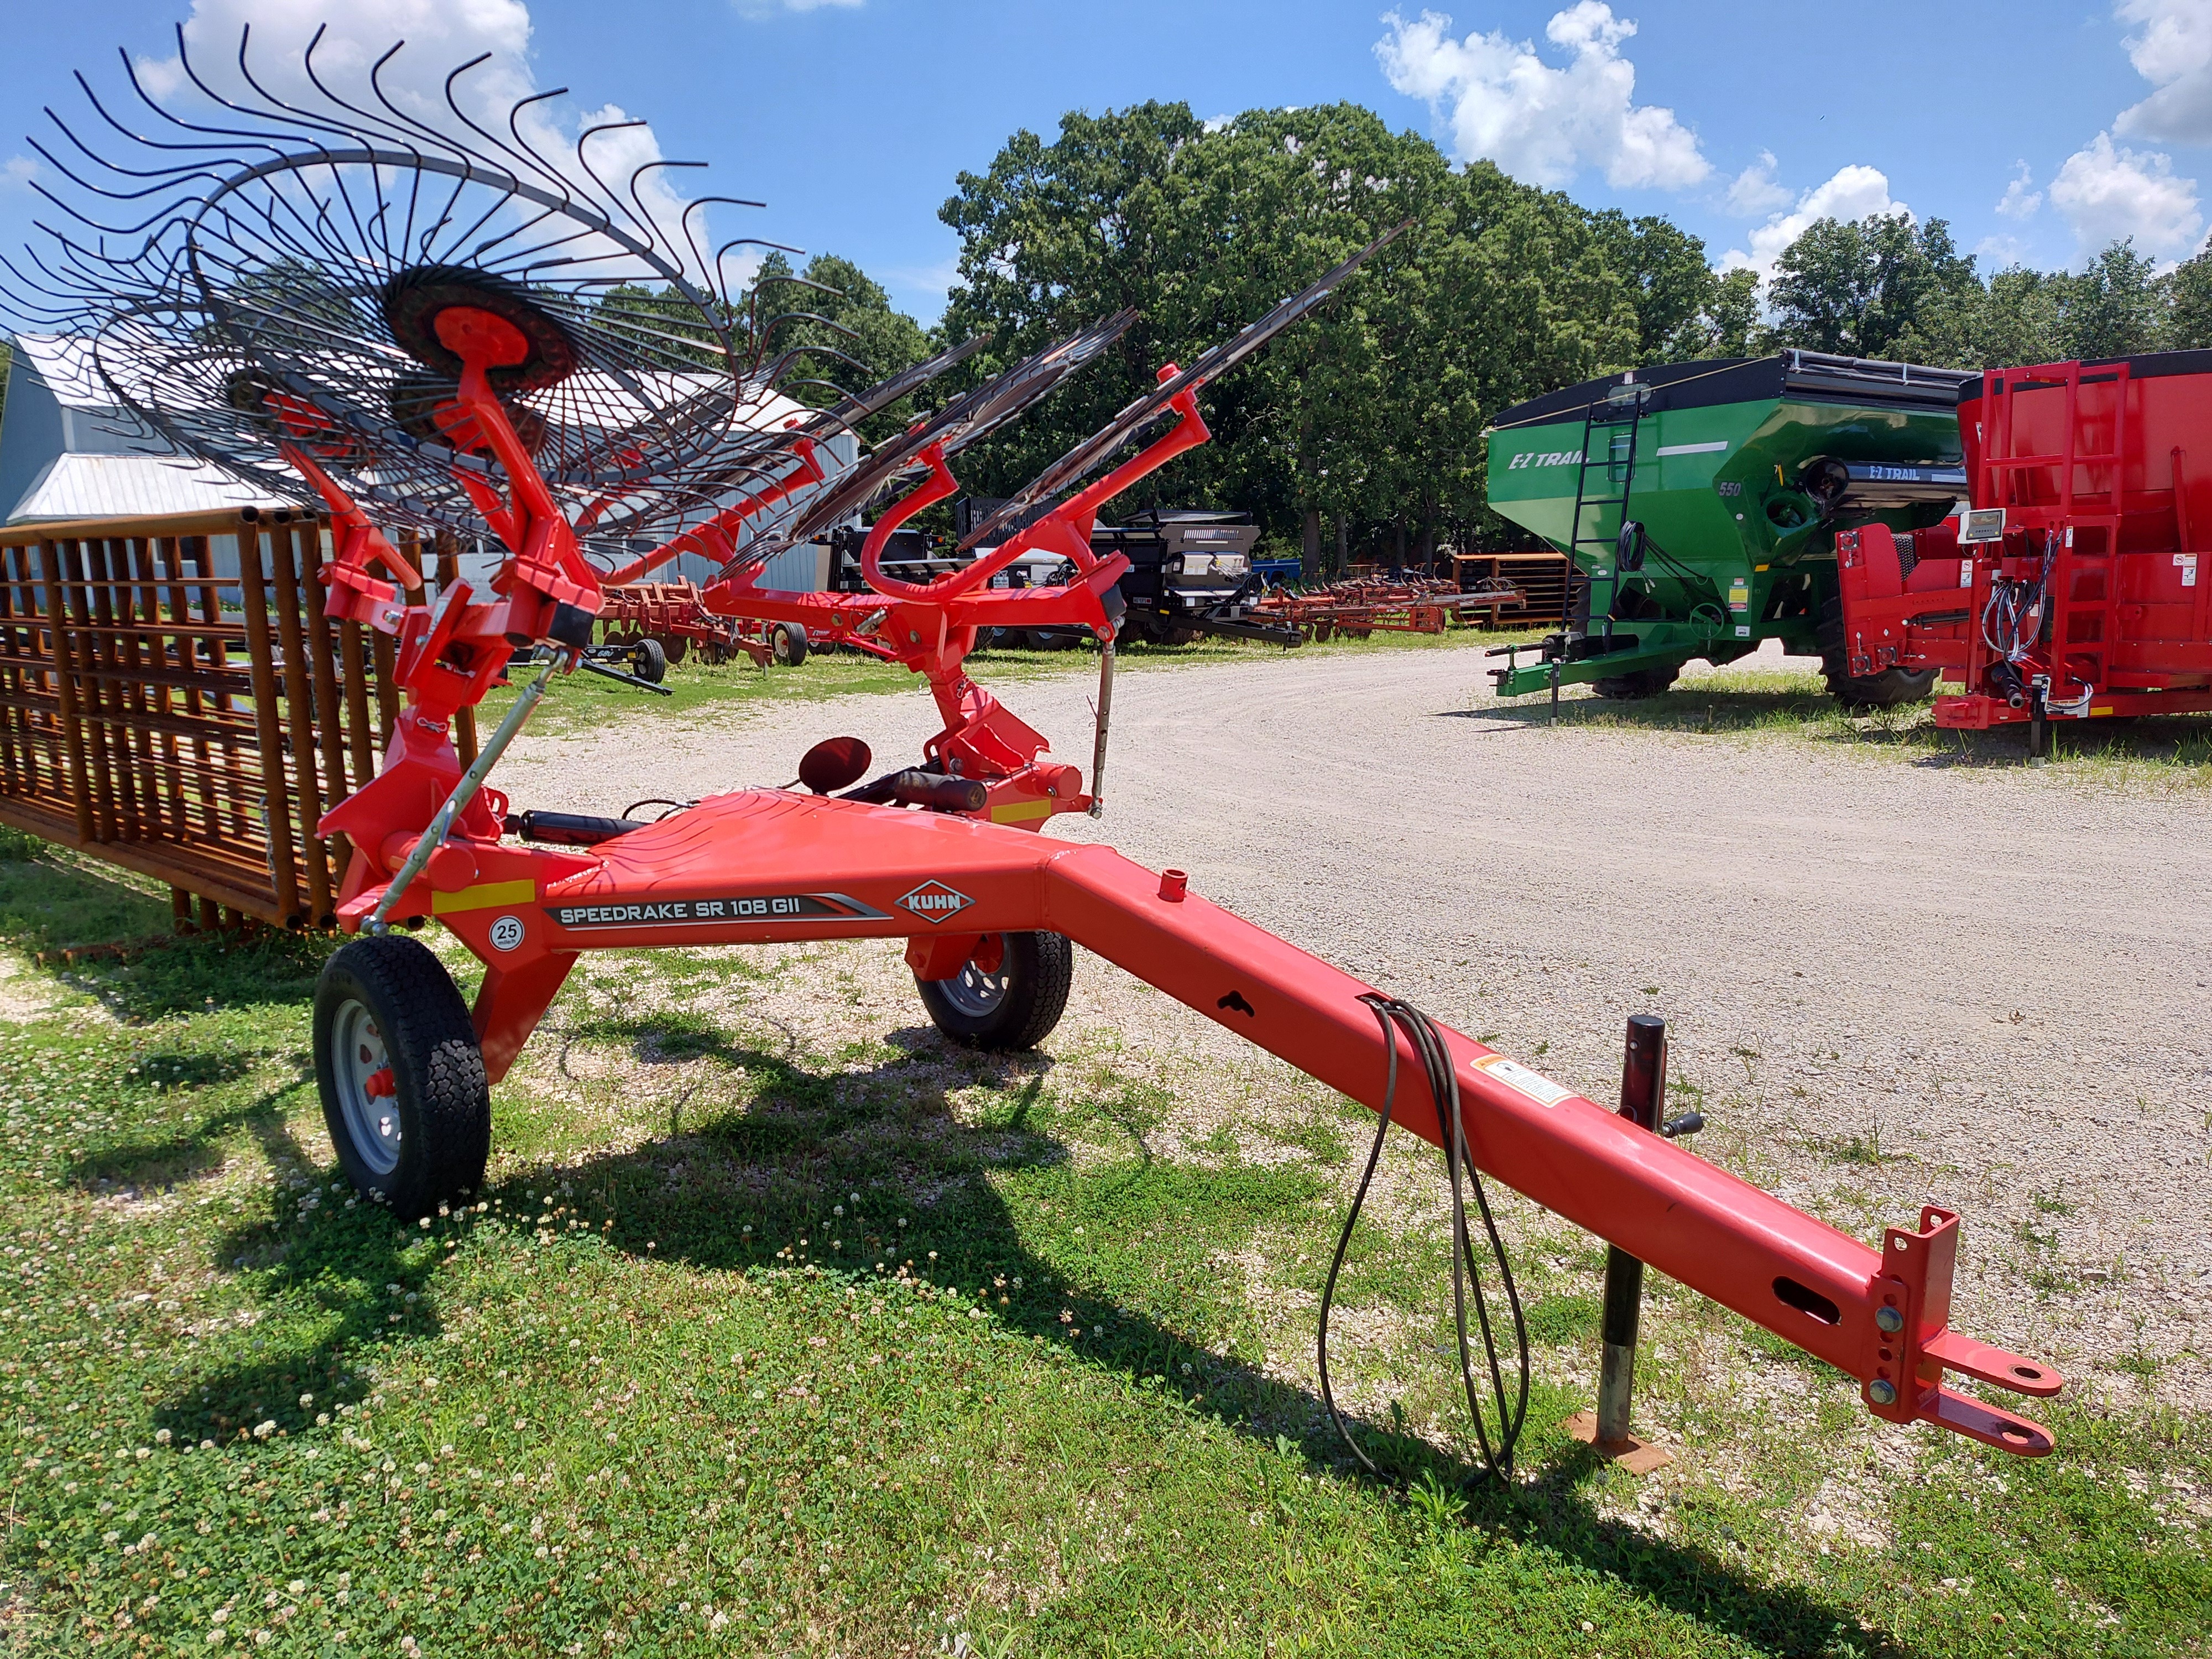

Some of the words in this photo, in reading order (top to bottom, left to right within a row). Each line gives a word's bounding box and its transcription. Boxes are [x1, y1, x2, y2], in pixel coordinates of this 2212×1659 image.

[1508, 452, 1535, 469] E-Z
[1869, 466, 1883, 479] E-Z
[1886, 467, 1920, 481] TRAIL
[1719, 482, 1741, 497] 550
[908, 895, 961, 910] KUHN
[560, 903, 688, 924] SPEEDRAKE
[695, 901, 725, 917] SR
[730, 899, 768, 916] 108
[771, 898, 800, 913] GII
[497, 924, 517, 940] 25
